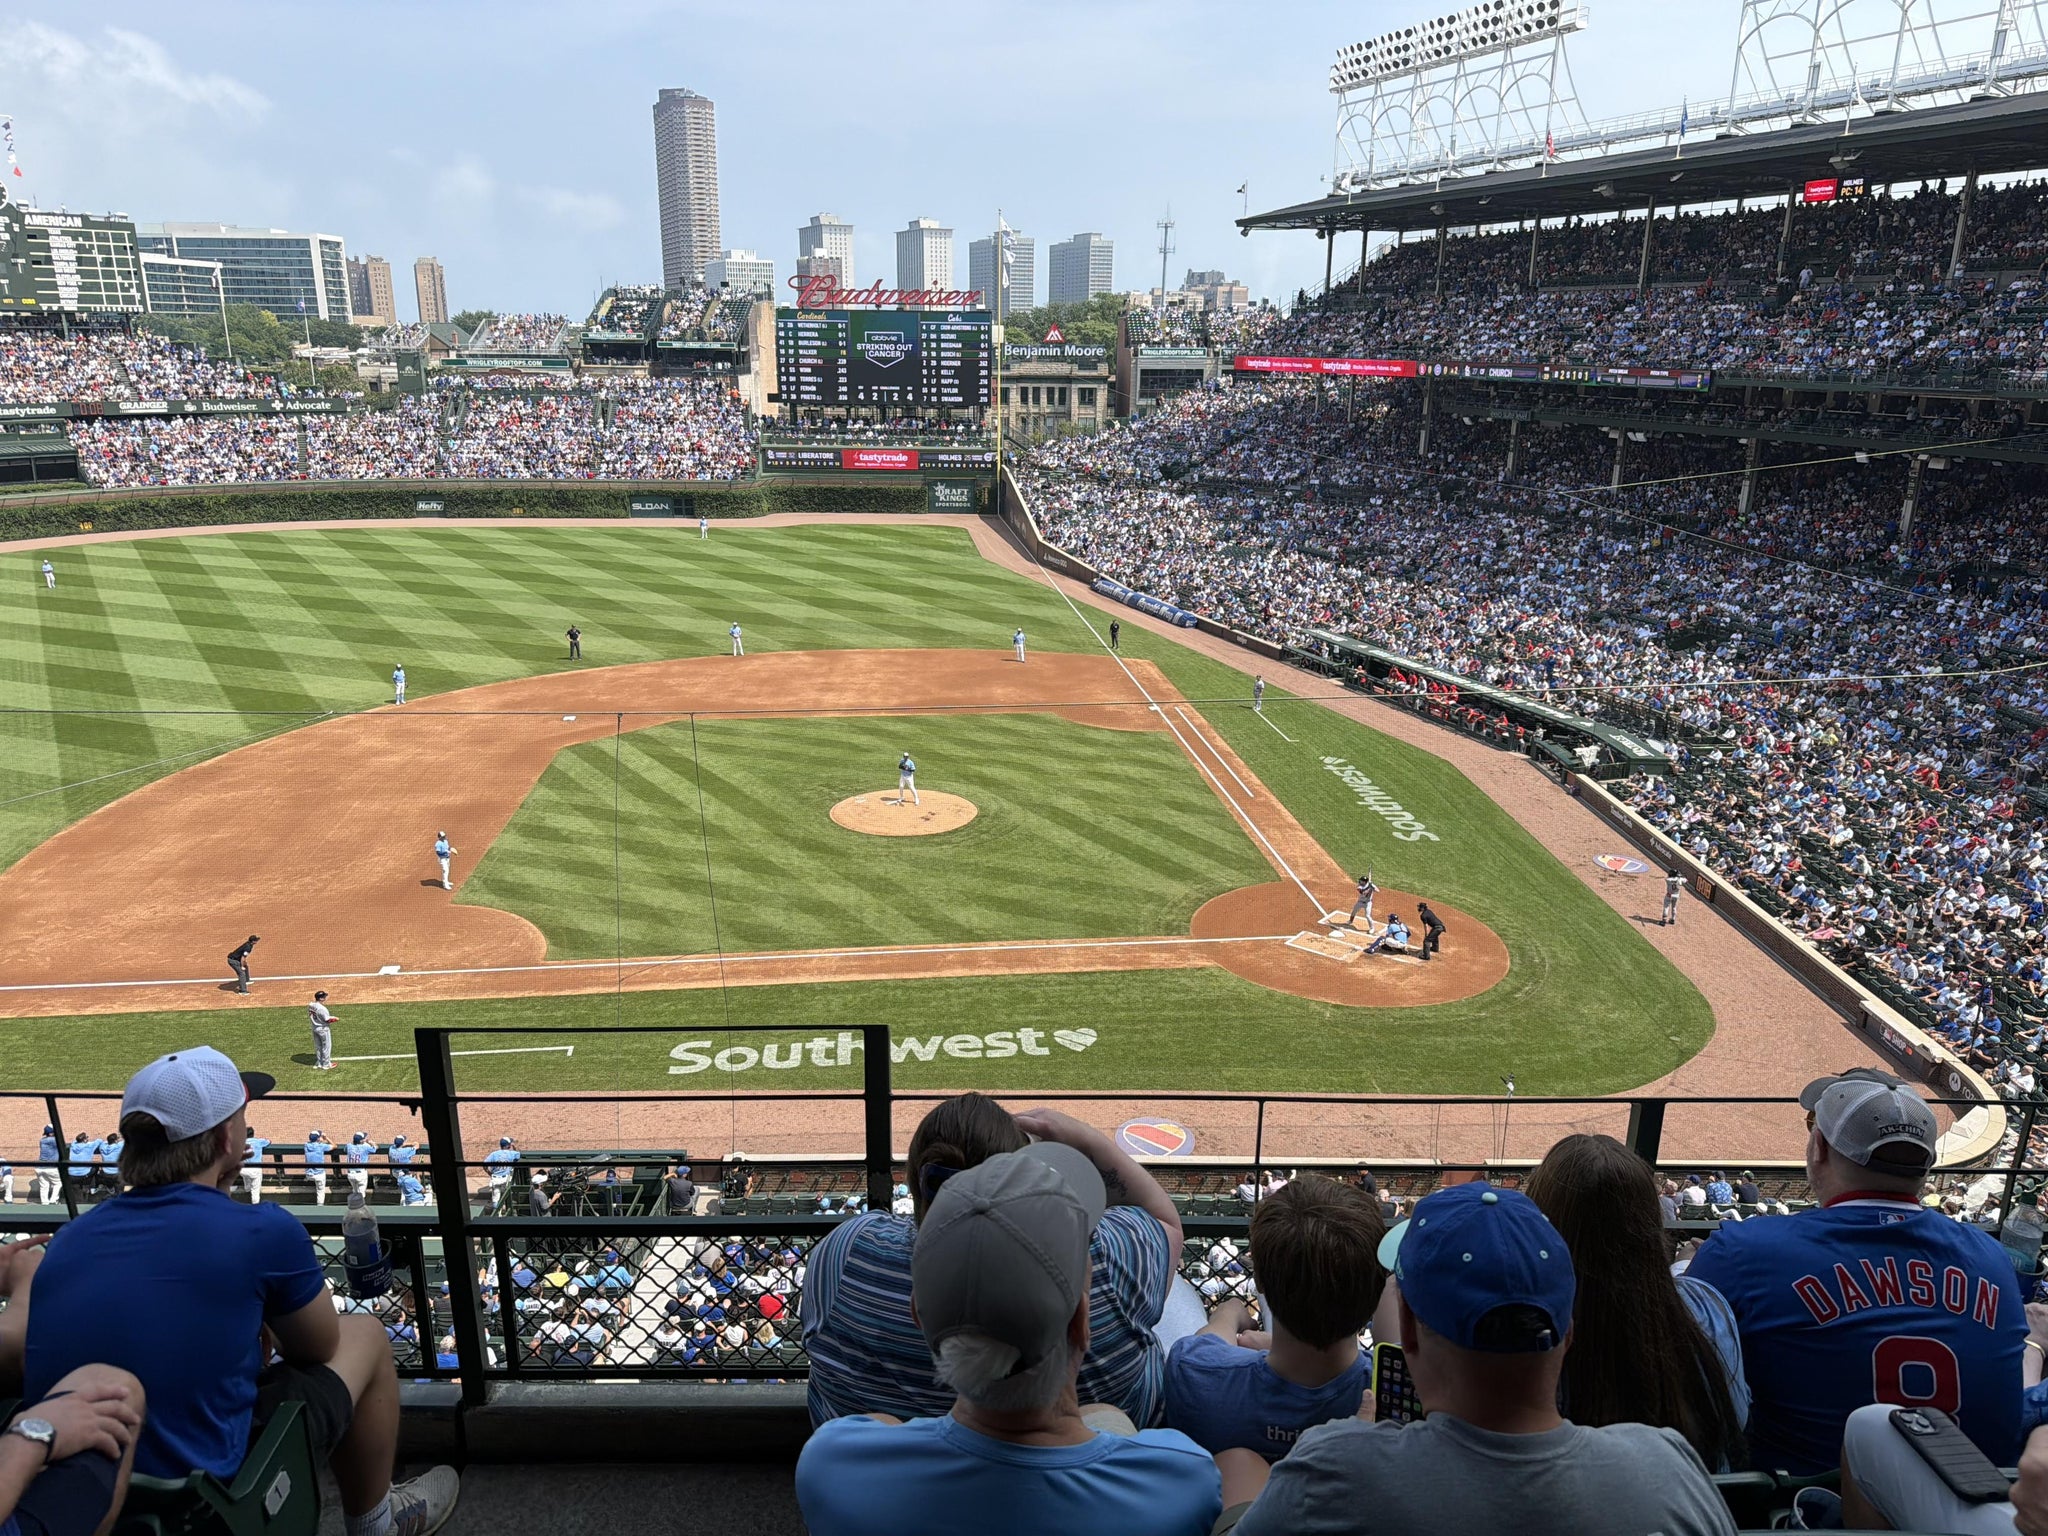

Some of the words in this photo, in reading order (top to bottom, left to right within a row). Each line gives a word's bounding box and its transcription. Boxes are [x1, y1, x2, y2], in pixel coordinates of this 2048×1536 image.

[1841, 188, 1852, 196] PC:
[1854, 186, 1863, 195] 14
[24, 214, 82, 227] AMERICAN
[788, 274, 981, 308] Budweiser
[797, 312, 827, 320] Cardinals
[948, 314, 962, 322] Cubs
[1004, 344, 1060, 358] Benjamin
[1064, 345, 1102, 357] Moore
[1247, 359, 1271, 368] tastytrade
[1323, 360, 1351, 371] tastytrade
[1488, 368, 1512, 378] CHURCH
[1560, 371, 1564, 380] 2
[119, 402, 168, 410] GRAINGER
[286, 401, 332, 410] Advocate
[0, 406, 56, 417] tastytrade
[859, 453, 908, 463] tastytrade
[935, 488, 969, 497] DRAFT
[418, 502, 442, 510] Hefty
[1137, 598, 1160, 612] Reynolds
[1159, 606, 1174, 622] Wrap
[1322, 764, 1440, 842] Southwest
[1891, 1034, 1907, 1051] SHOP
[668, 1027, 1050, 1074] Southwest
[1880, 1125, 1923, 1136] AK-CHIN
[1792, 1256, 1999, 1330] DAWSON
